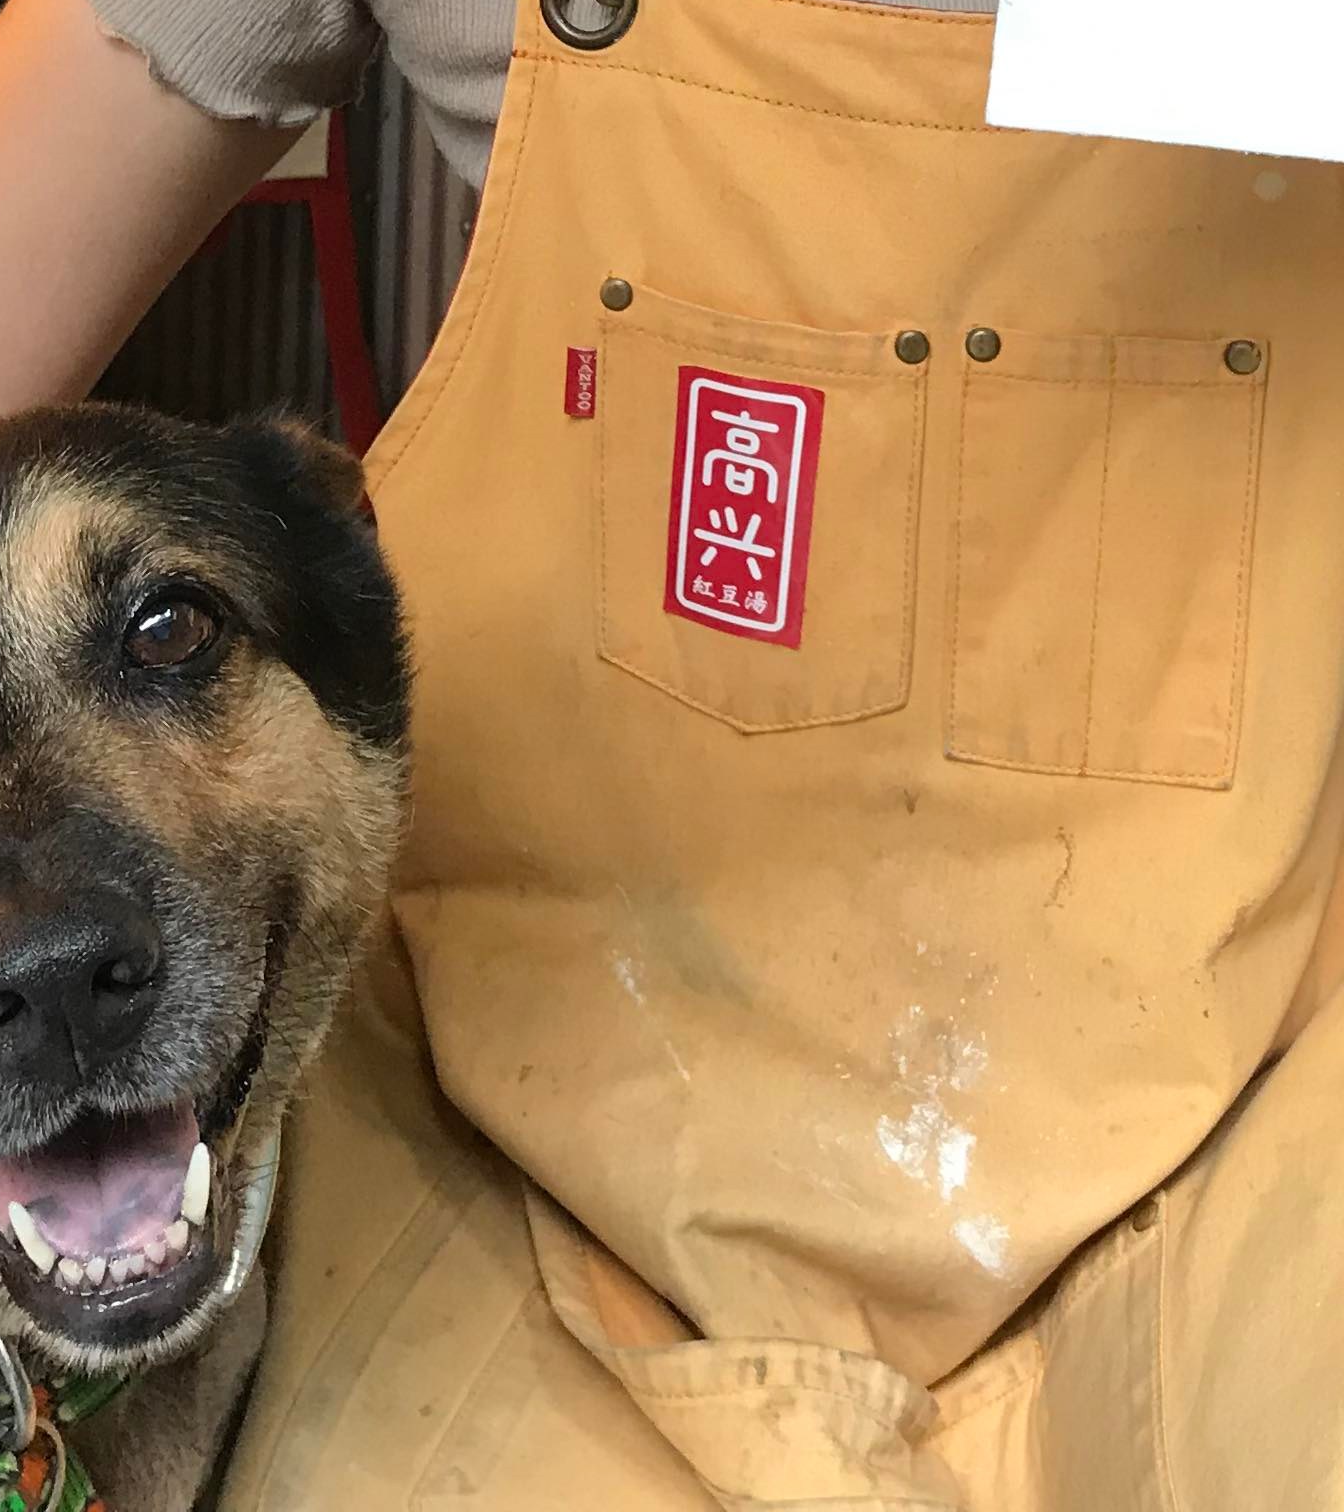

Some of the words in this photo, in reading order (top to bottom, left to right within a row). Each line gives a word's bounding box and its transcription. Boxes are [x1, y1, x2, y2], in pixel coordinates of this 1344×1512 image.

[577, 353, 594, 410] YANTOO
[693, 409, 780, 581] 高兴
[692, 574, 768, 615] 紅豆湯
